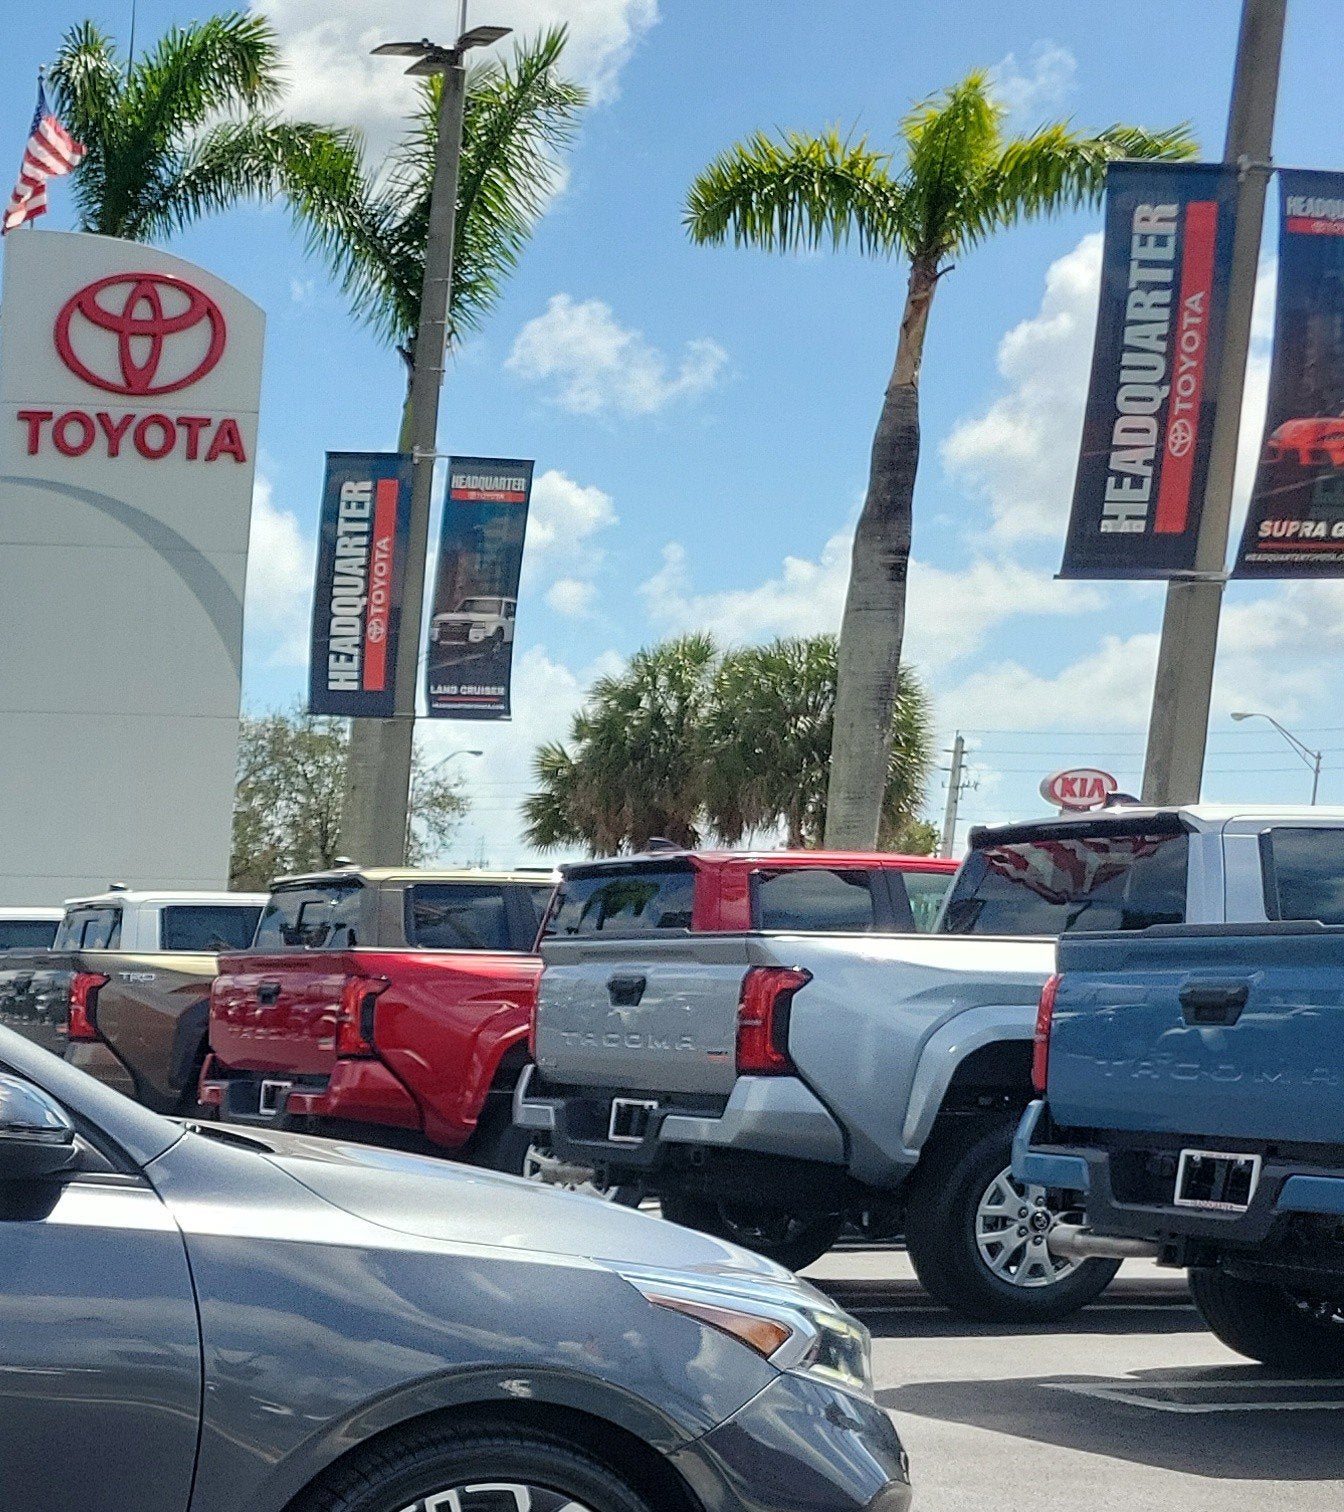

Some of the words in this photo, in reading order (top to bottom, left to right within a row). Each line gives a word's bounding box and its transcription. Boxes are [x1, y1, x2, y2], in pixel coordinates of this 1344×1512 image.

[1100, 203, 1180, 533] HEADQUARTER
[1174, 290, 1205, 414] TOYOTA
[17, 410, 246, 463] TOYOTA
[1258, 520, 1327, 538] SUPRA
[328, 480, 374, 691] HEADQUARTER
[370, 536, 391, 616] TOYOTA
[430, 685, 457, 695] LAND
[460, 685, 505, 695] CRUISER
[1059, 778, 1106, 799] KIA
[119, 972, 156, 982] TRD
[561, 1031, 698, 1051] TACOMA
